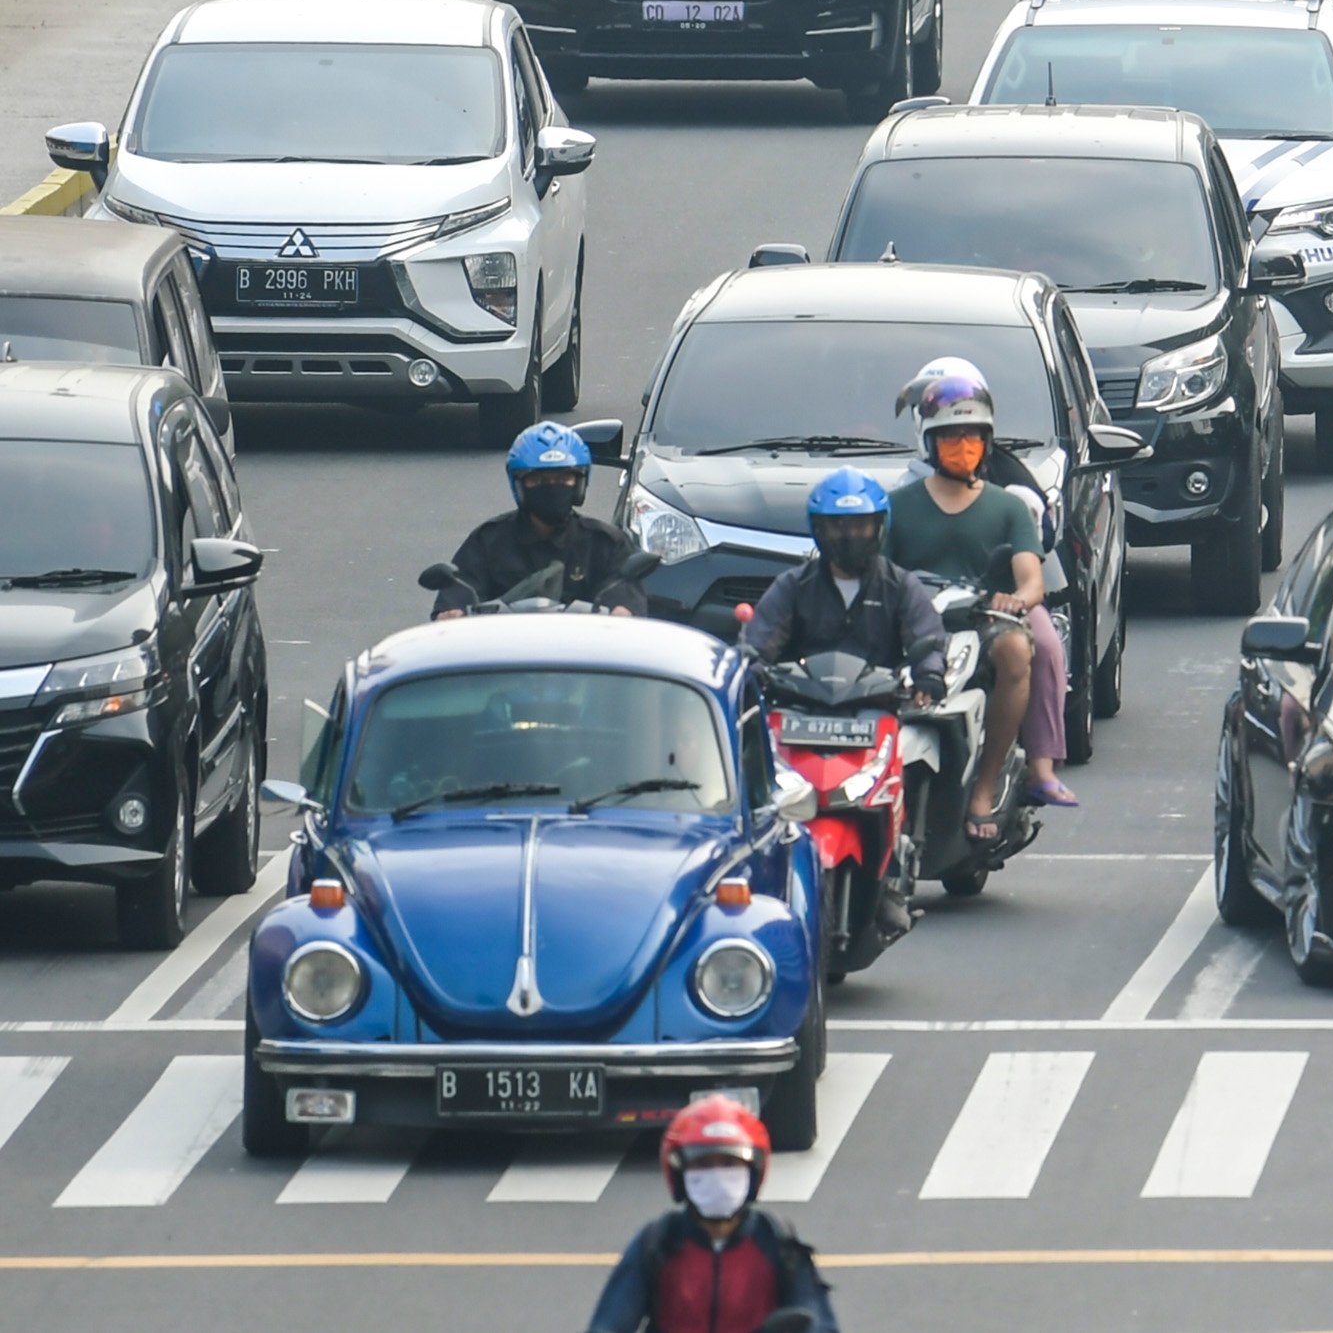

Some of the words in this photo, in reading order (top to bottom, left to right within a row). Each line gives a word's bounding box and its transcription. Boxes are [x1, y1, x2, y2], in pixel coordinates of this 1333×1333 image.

[685, 4, 701, 21] 12
[239, 268, 250, 289] B
[264, 269, 308, 289] 2996
[323, 270, 356, 291] PKH
[442, 1071, 457, 1098] B
[486, 1071, 541, 1098] 1513
[569, 1072, 598, 1099] KA
